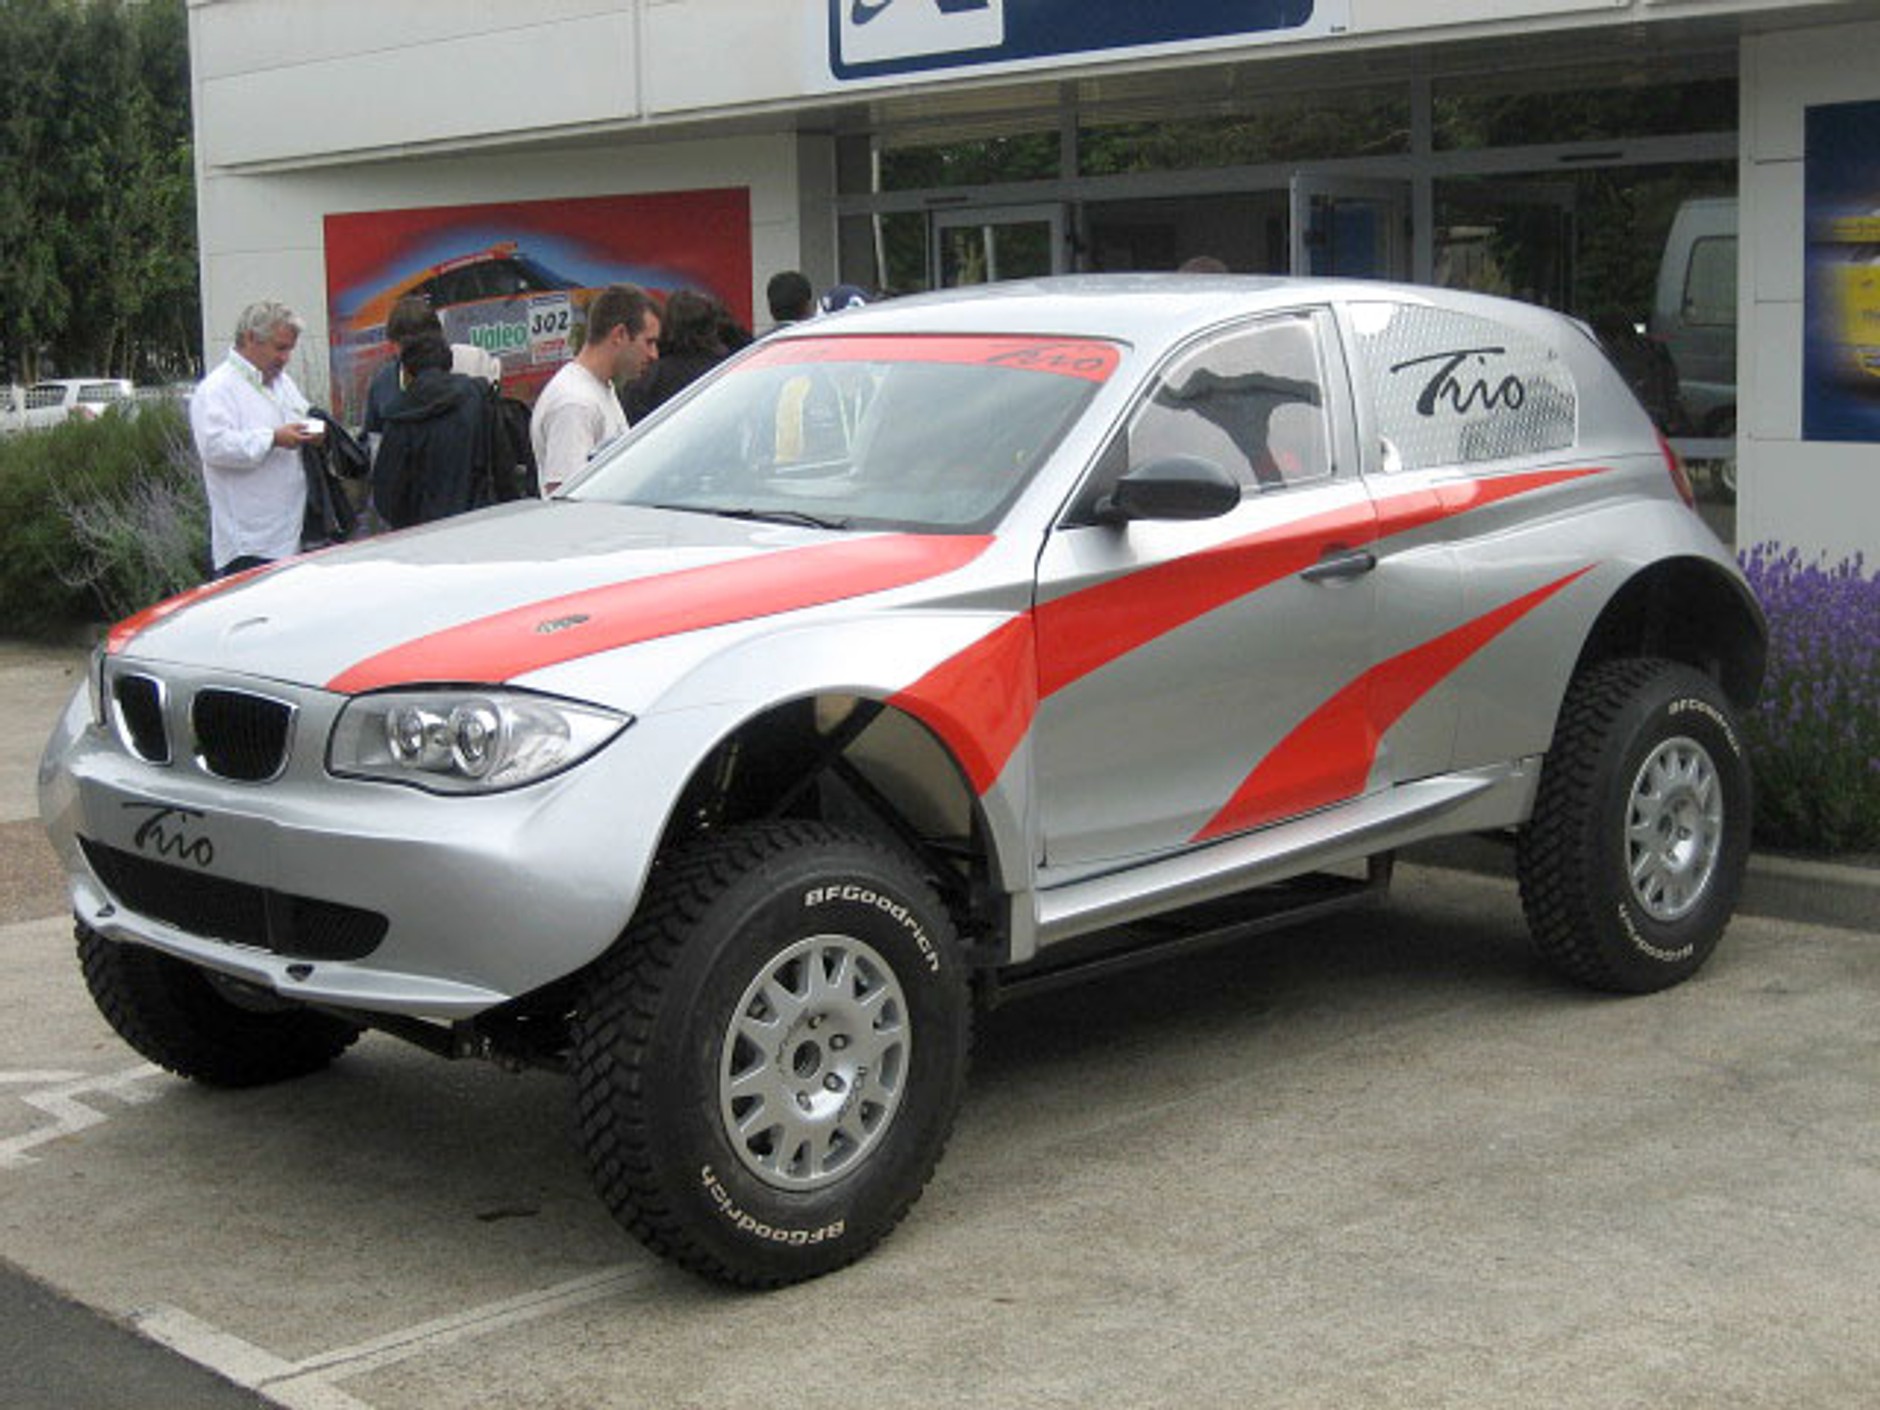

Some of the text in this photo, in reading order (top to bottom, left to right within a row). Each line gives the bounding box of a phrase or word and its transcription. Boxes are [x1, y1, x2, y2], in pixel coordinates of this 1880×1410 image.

[532, 310, 569, 335] 302
[986, 343, 1106, 370] Trio
[1390, 347, 1524, 415] Trio
[122, 801, 213, 867] Trio
[805, 884, 939, 971] BFGoodrich
[702, 1164, 845, 1246] BFGoodrich
